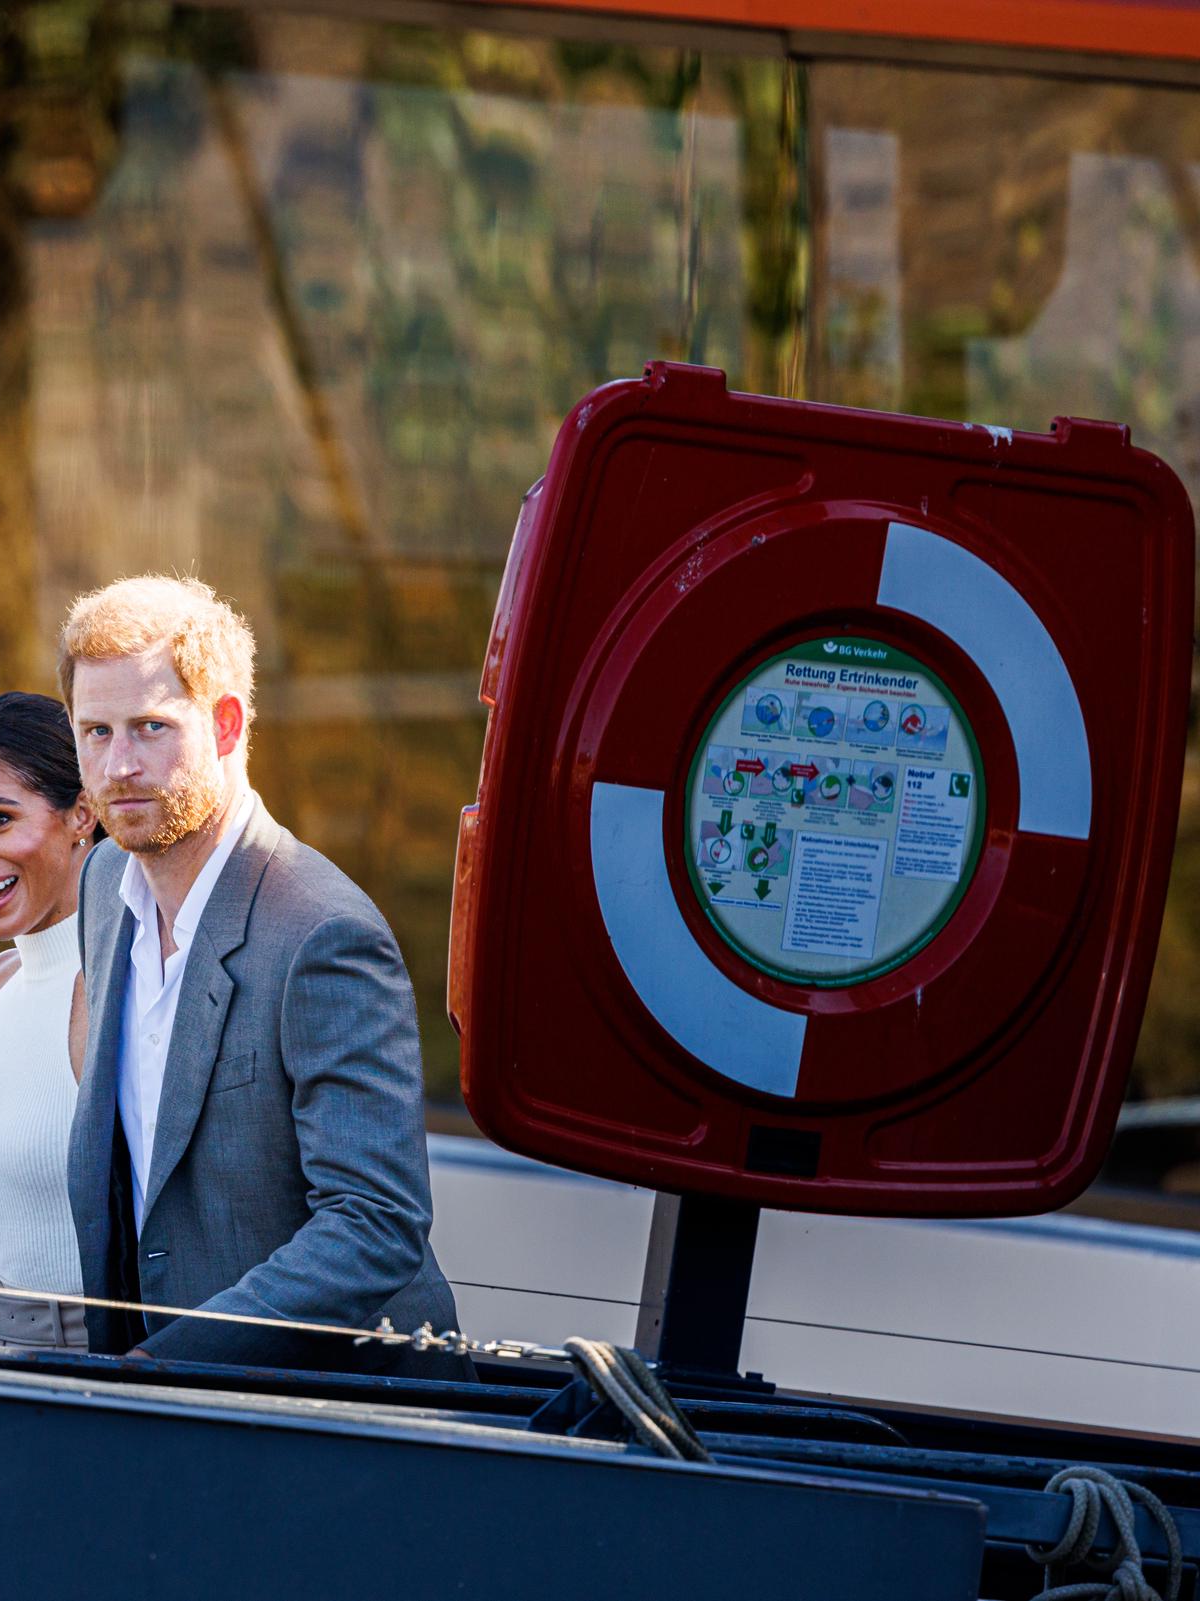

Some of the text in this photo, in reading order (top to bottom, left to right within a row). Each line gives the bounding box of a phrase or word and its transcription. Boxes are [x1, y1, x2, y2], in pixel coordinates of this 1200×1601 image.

[838, 645, 888, 659] BG Verkehr
[786, 663, 919, 690] Rettung Ertrinkender
[907, 769, 935, 780] Notruf
[907, 781, 923, 790] 112
